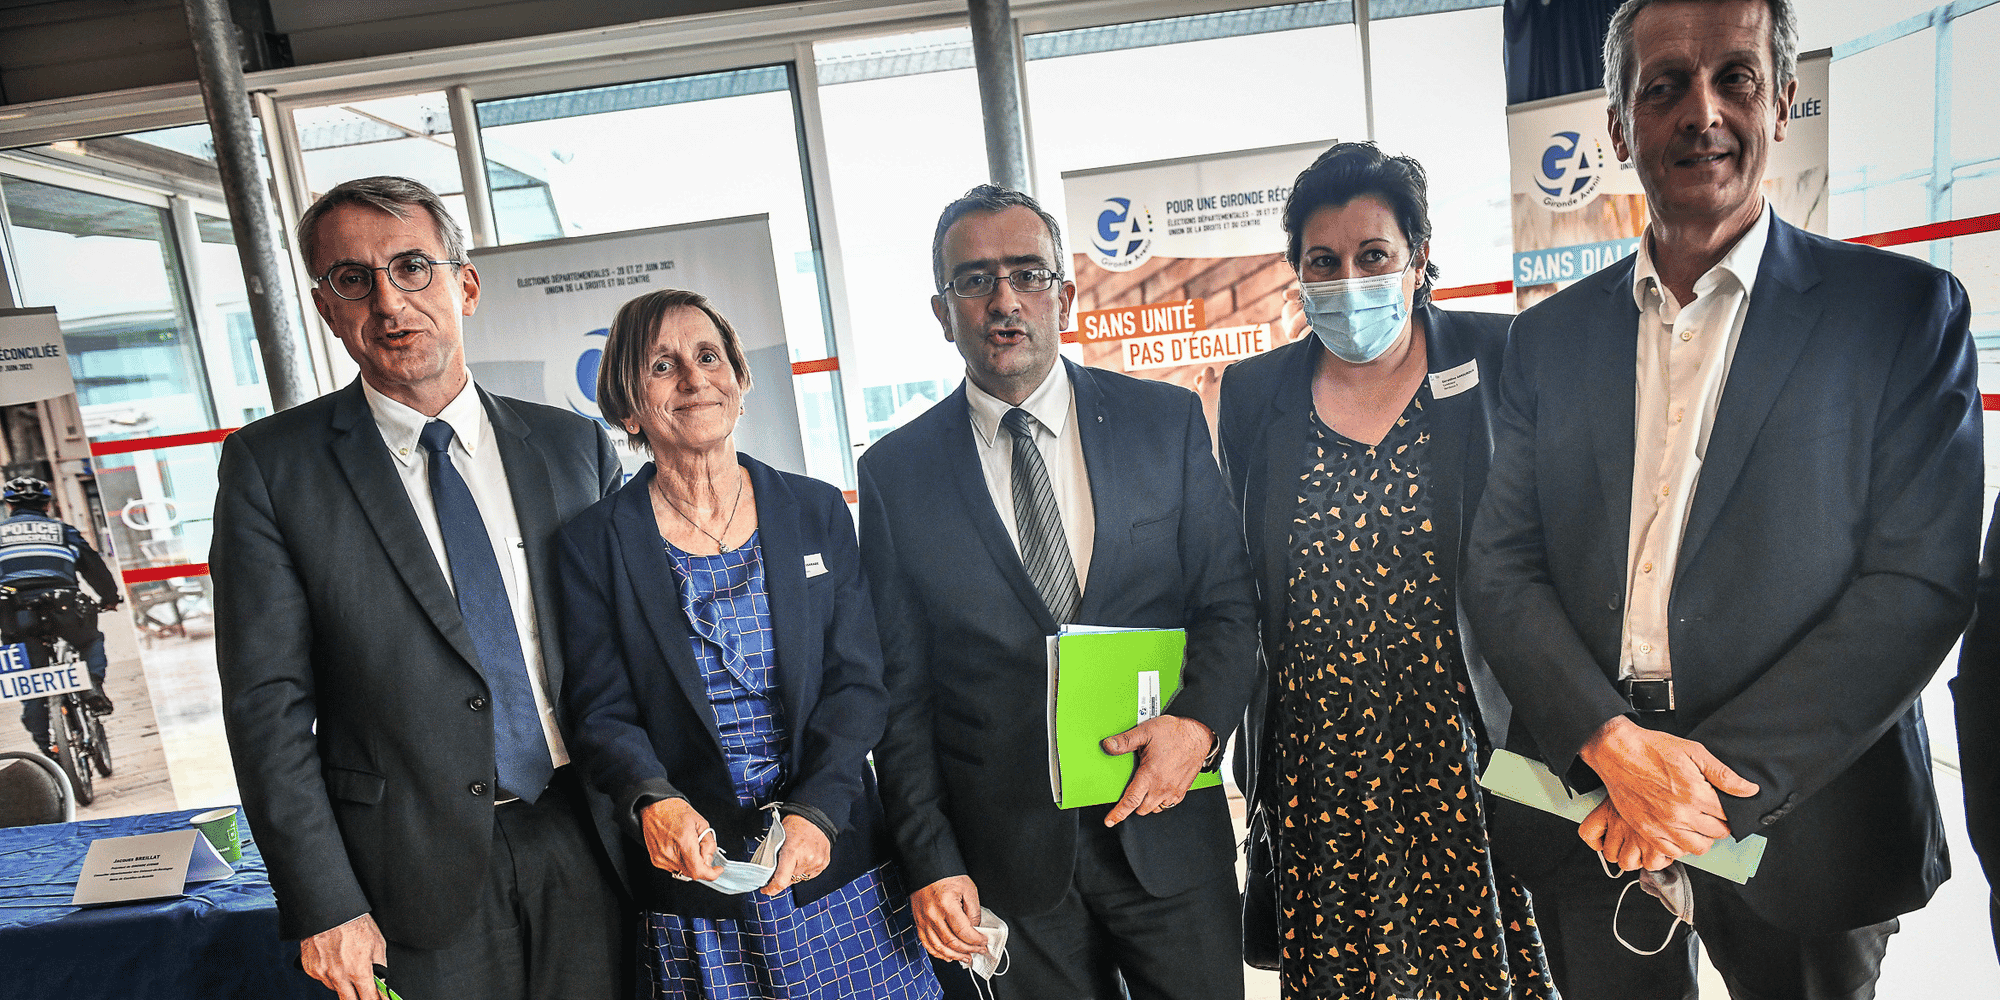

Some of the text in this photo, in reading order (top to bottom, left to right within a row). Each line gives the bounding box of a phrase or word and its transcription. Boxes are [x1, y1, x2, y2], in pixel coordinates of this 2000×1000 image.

[1166, 198, 1194, 214] POUR
[1197, 195, 1218, 211] UNE
[1220, 190, 1264, 208] GIRONDE
[1543, 175, 1601, 208] Gironde Avenir
[1168, 227, 1185, 236] UNION
[1186, 226, 1193, 234] DE
[1194, 225, 1202, 233] LA
[1203, 222, 1222, 232] DROITE
[1240, 218, 1260, 228] CENTRE
[517, 276, 550, 288] ÉLECTIONS
[551, 268, 610, 283] DÉPARTEMENTALES
[1519, 250, 1574, 283] SANS
[544, 285, 564, 295] UNION
[565, 283, 573, 293] DE
[574, 282, 583, 291] LA
[584, 279, 606, 290] DROITE
[607, 278, 615, 288] ET
[626, 273, 650, 285] CENTRE
[1084, 299, 1196, 340] SANS UNITÉ
[1129, 325, 1264, 366] PAS D'ÉGALITÉ
[1, 522, 59, 536] POLICE
[1, 662, 81, 698] LIBERTÉ
